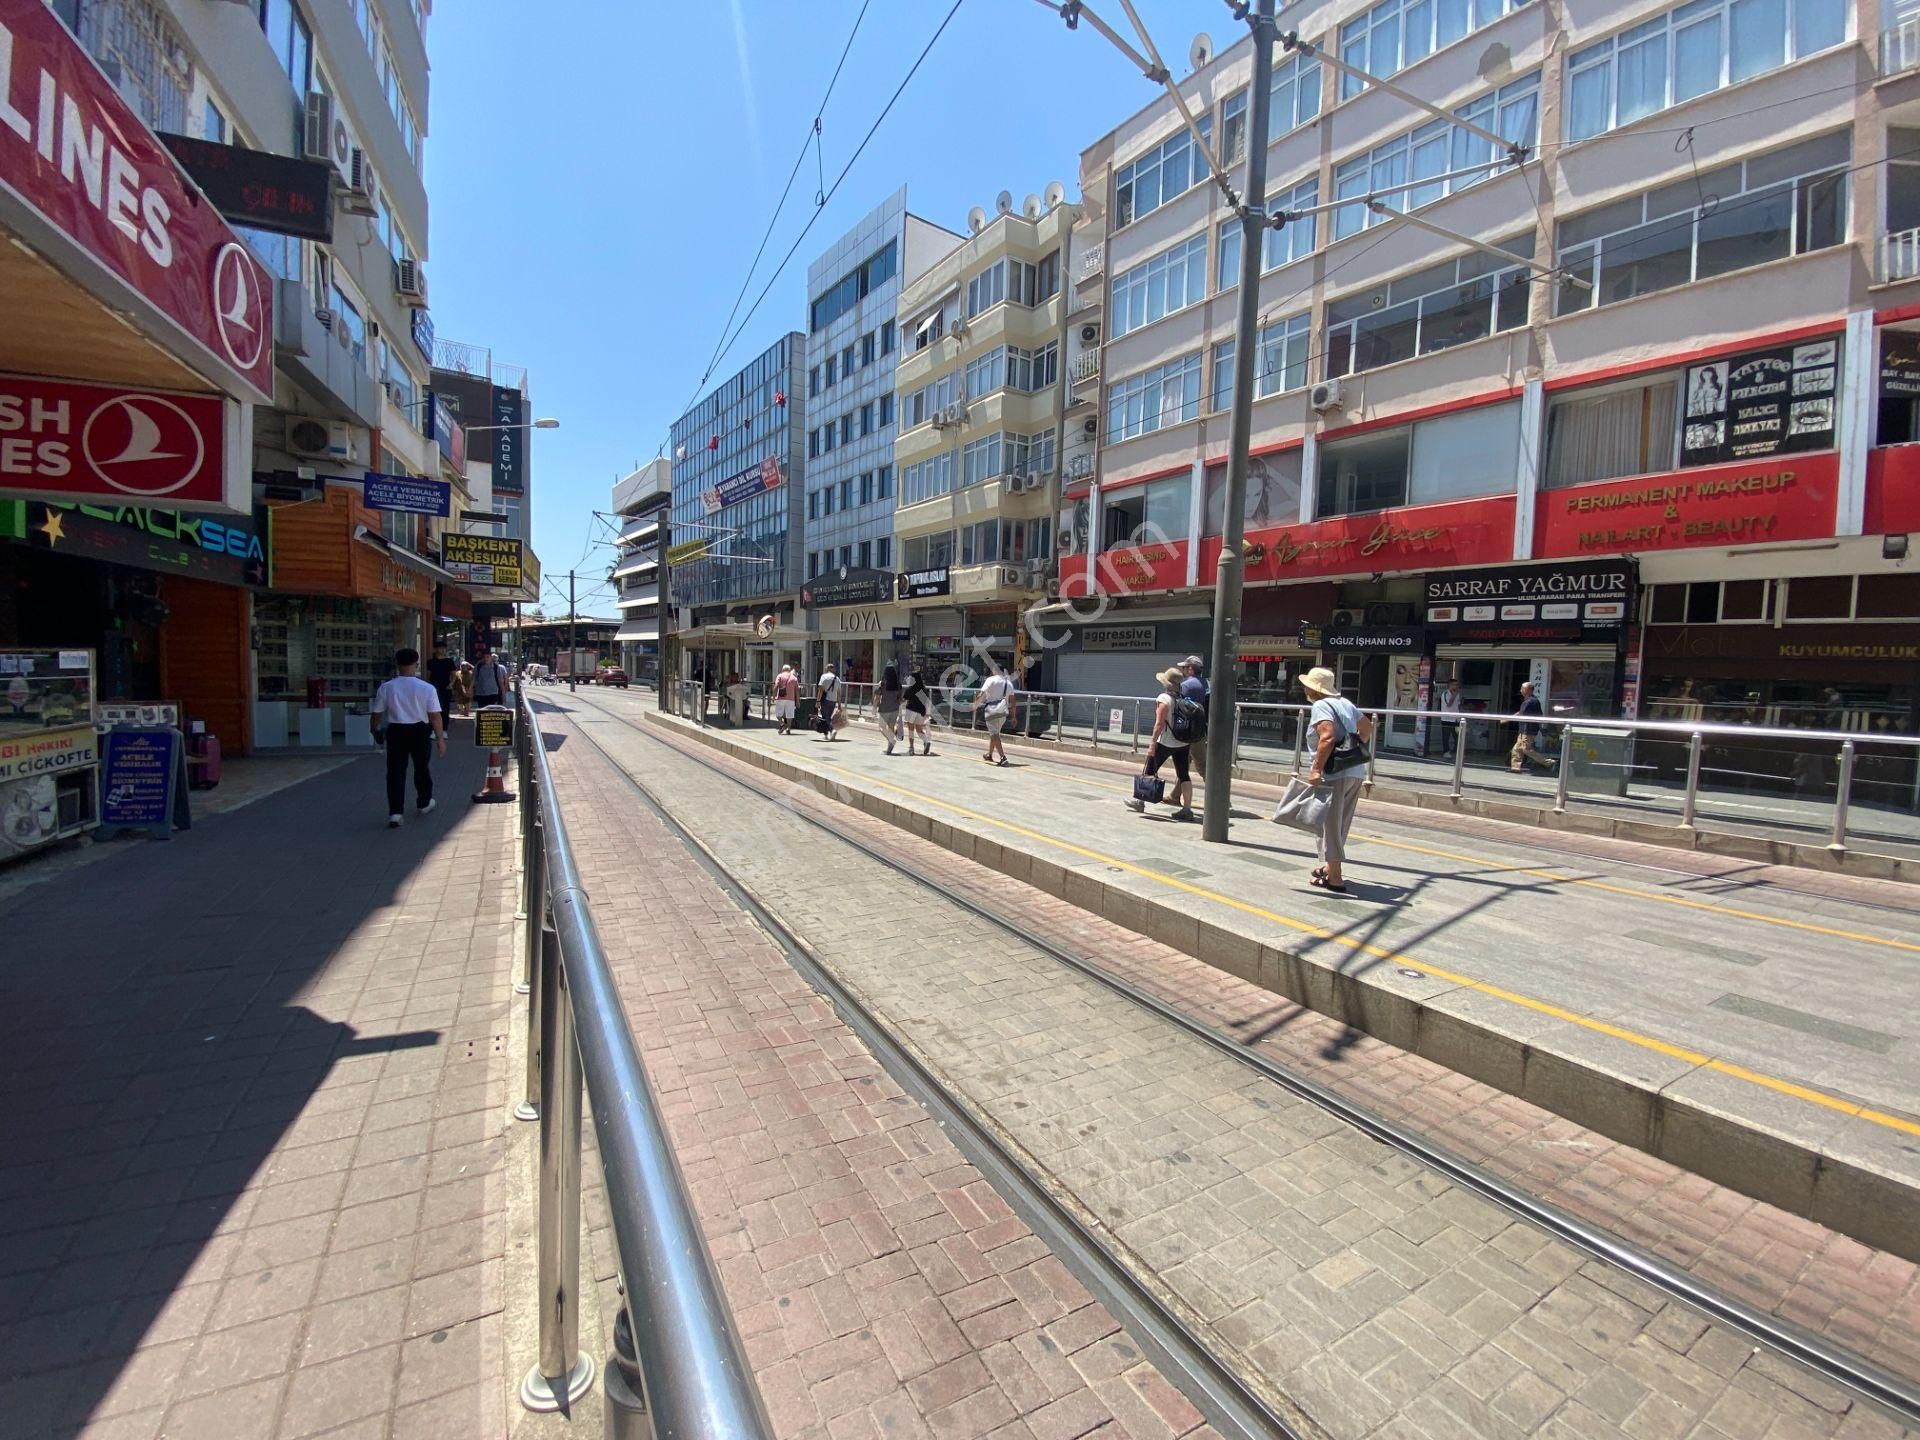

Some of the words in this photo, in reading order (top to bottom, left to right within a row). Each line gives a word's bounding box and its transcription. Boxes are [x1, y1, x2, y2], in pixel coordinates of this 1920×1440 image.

[1729, 358, 1791, 381] TATTOO
[0, 394, 70, 434] SH
[1, 437, 72, 477] ES
[368, 490, 395, 499] ACELE
[396, 492, 445, 505] BİYOMETRİK
[371, 483, 398, 493] ACELE
[400, 486, 441, 498] VESİKALIK
[1566, 484, 1692, 512] PERMANENT
[1696, 472, 1796, 496] MAKEUP
[1664, 505, 1678, 519] &
[1579, 525, 1664, 546] NAILART
[1682, 515, 1775, 537] BEAUTY
[447, 536, 519, 553] BAŞKENT
[446, 551, 518, 566] AKSESUAR
[1428, 579, 1512, 598] SARRAF
[1518, 572, 1626, 594] YAĞMUR
[839, 610, 882, 632] LOYA
[1084, 629, 1152, 642] aggressive
[1329, 636, 1354, 646] OĞUZ
[1355, 635, 1387, 647] İŞHANI
[1388, 637, 1412, 646] NO:9
[1779, 645, 1919, 659] KUYUMCULUK
